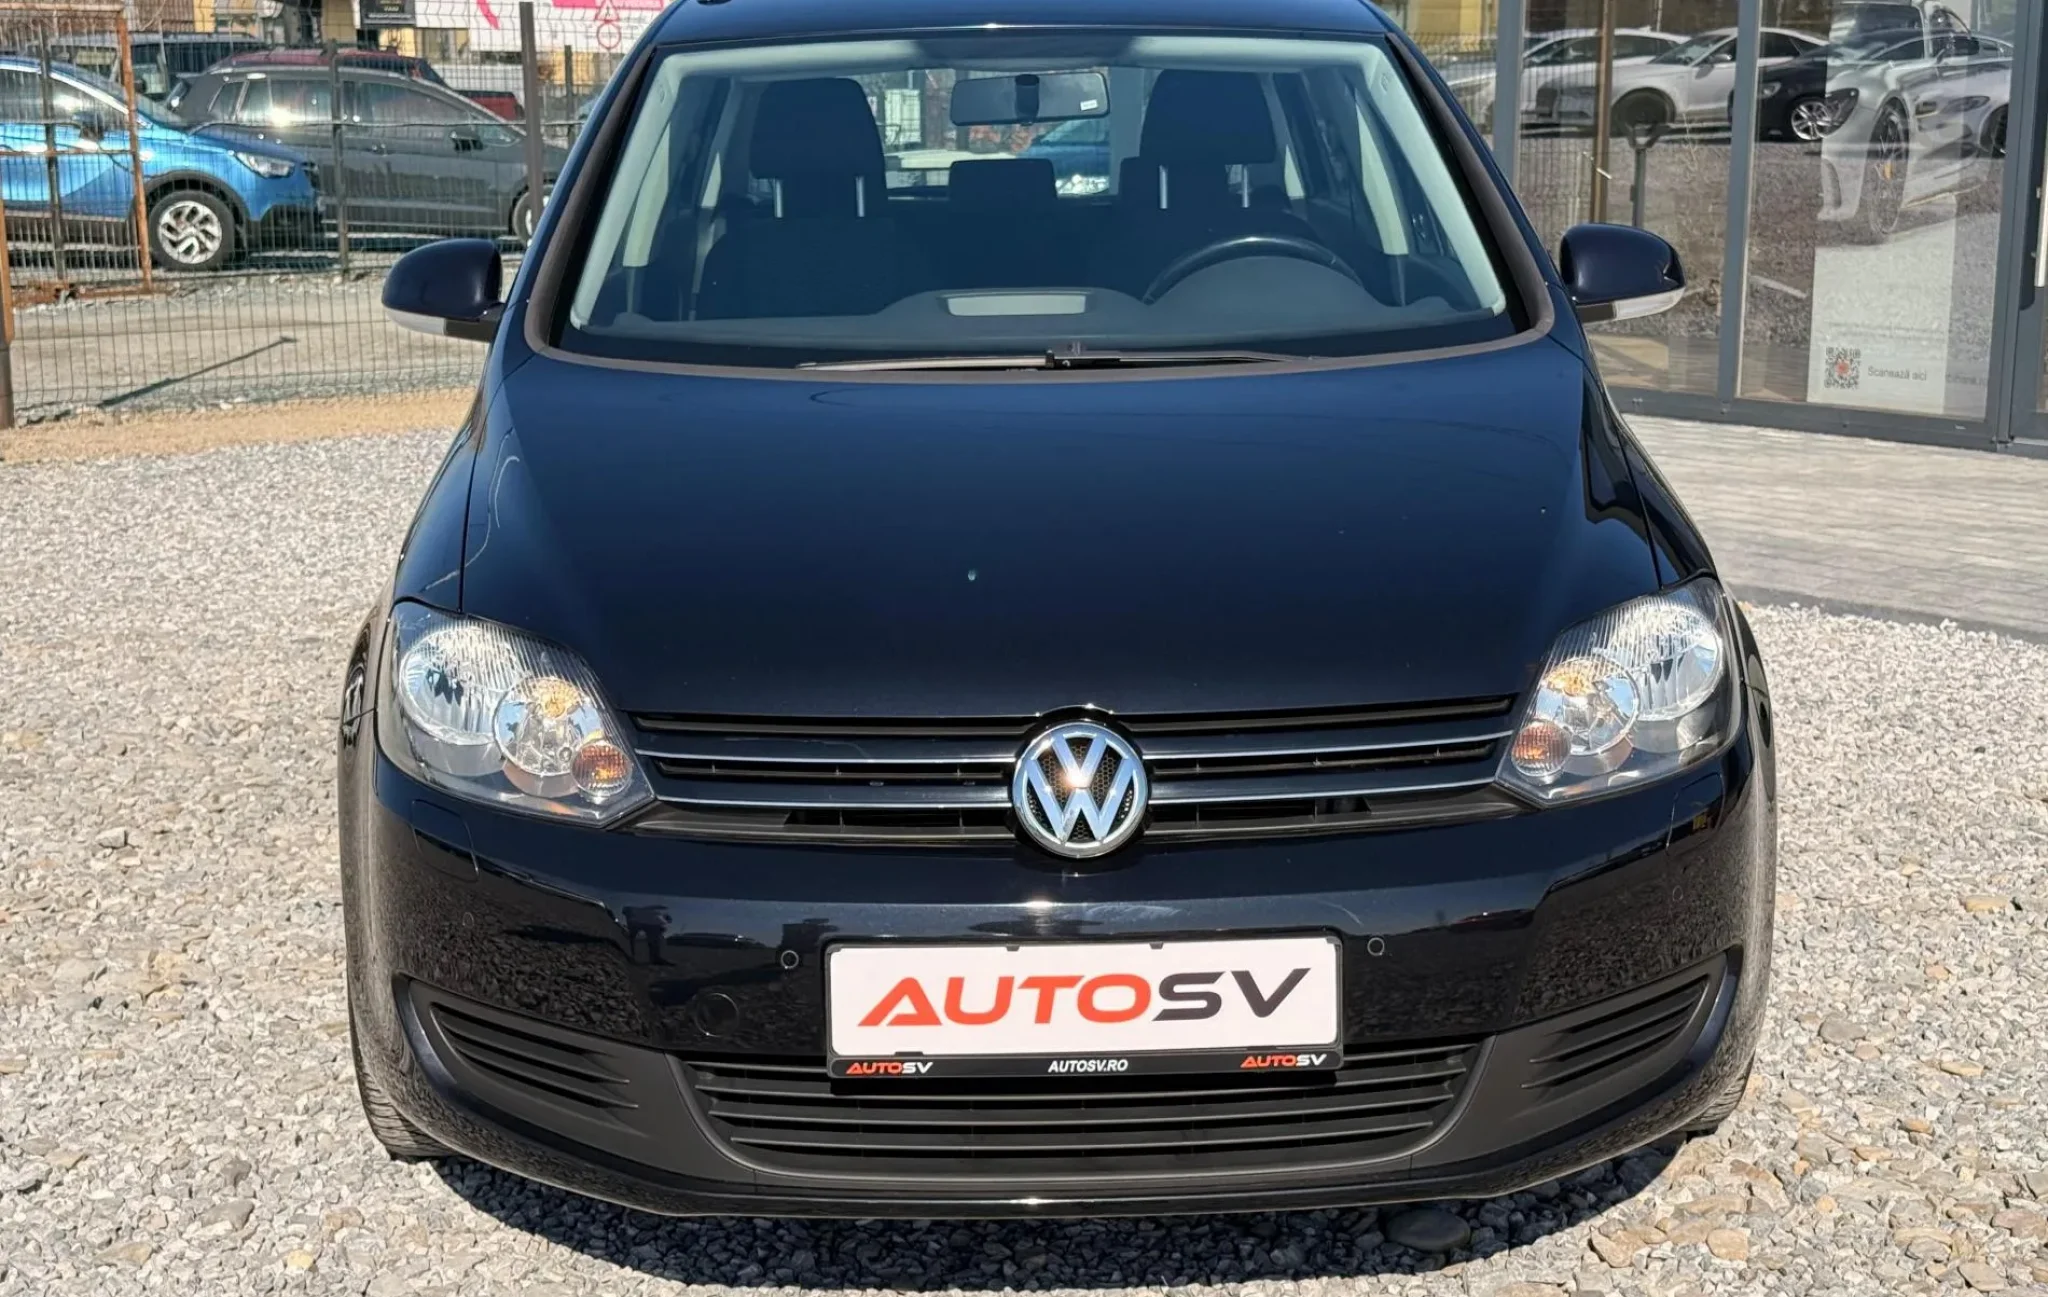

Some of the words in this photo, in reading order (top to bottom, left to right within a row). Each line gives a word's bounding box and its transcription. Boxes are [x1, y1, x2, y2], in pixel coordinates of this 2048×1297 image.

[1020, 730, 1140, 846] VW
[858, 968, 1311, 1027] AUTOSV
[846, 1061, 933, 1076] AUTOSV
[1048, 1058, 1129, 1073] AUTOSV.RO
[1240, 1053, 1328, 1069] AUTOSV
